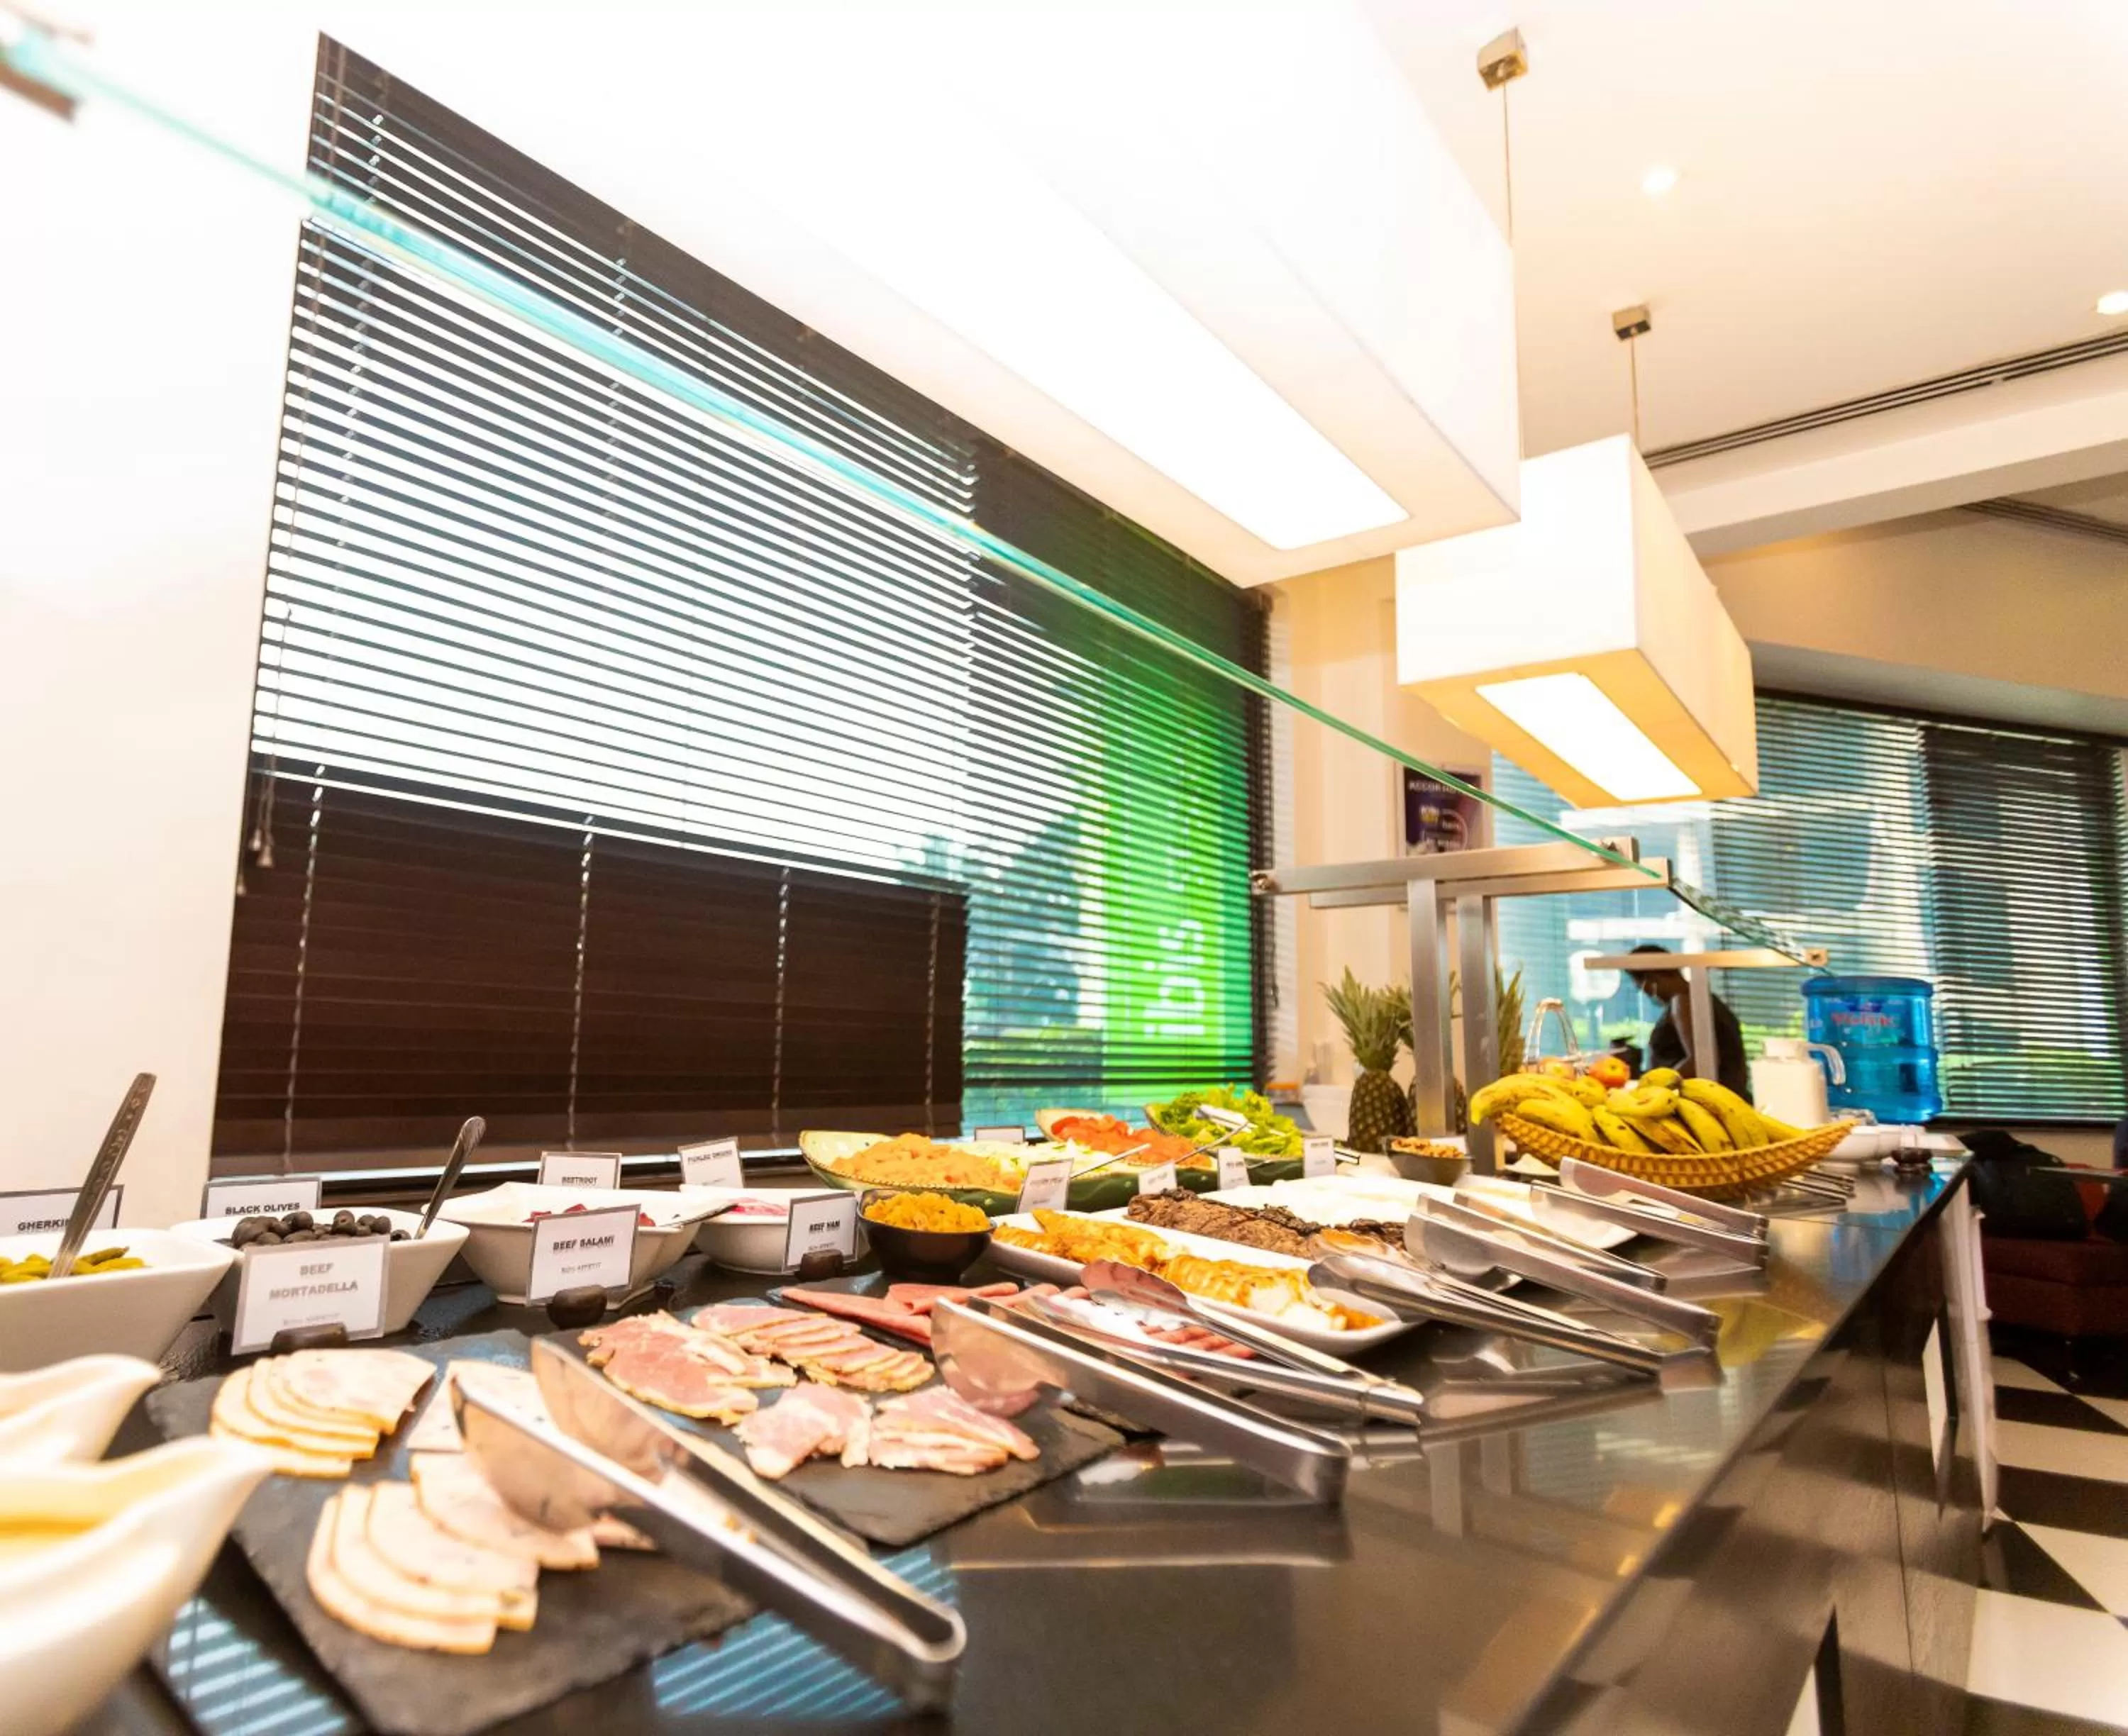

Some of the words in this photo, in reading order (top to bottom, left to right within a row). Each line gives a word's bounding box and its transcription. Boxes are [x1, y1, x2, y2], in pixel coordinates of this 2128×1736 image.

[1143, 920, 1204, 1040] ibis
[225, 1205, 260, 1215] BLACK
[263, 1202, 300, 1213] OLIVES
[809, 1222, 824, 1232] BEEF
[553, 1239, 577, 1251] BEEF
[580, 1234, 615, 1249] SALAMI
[299, 1262, 334, 1276] BEEF
[269, 1279, 358, 1300] MORTADELLA
